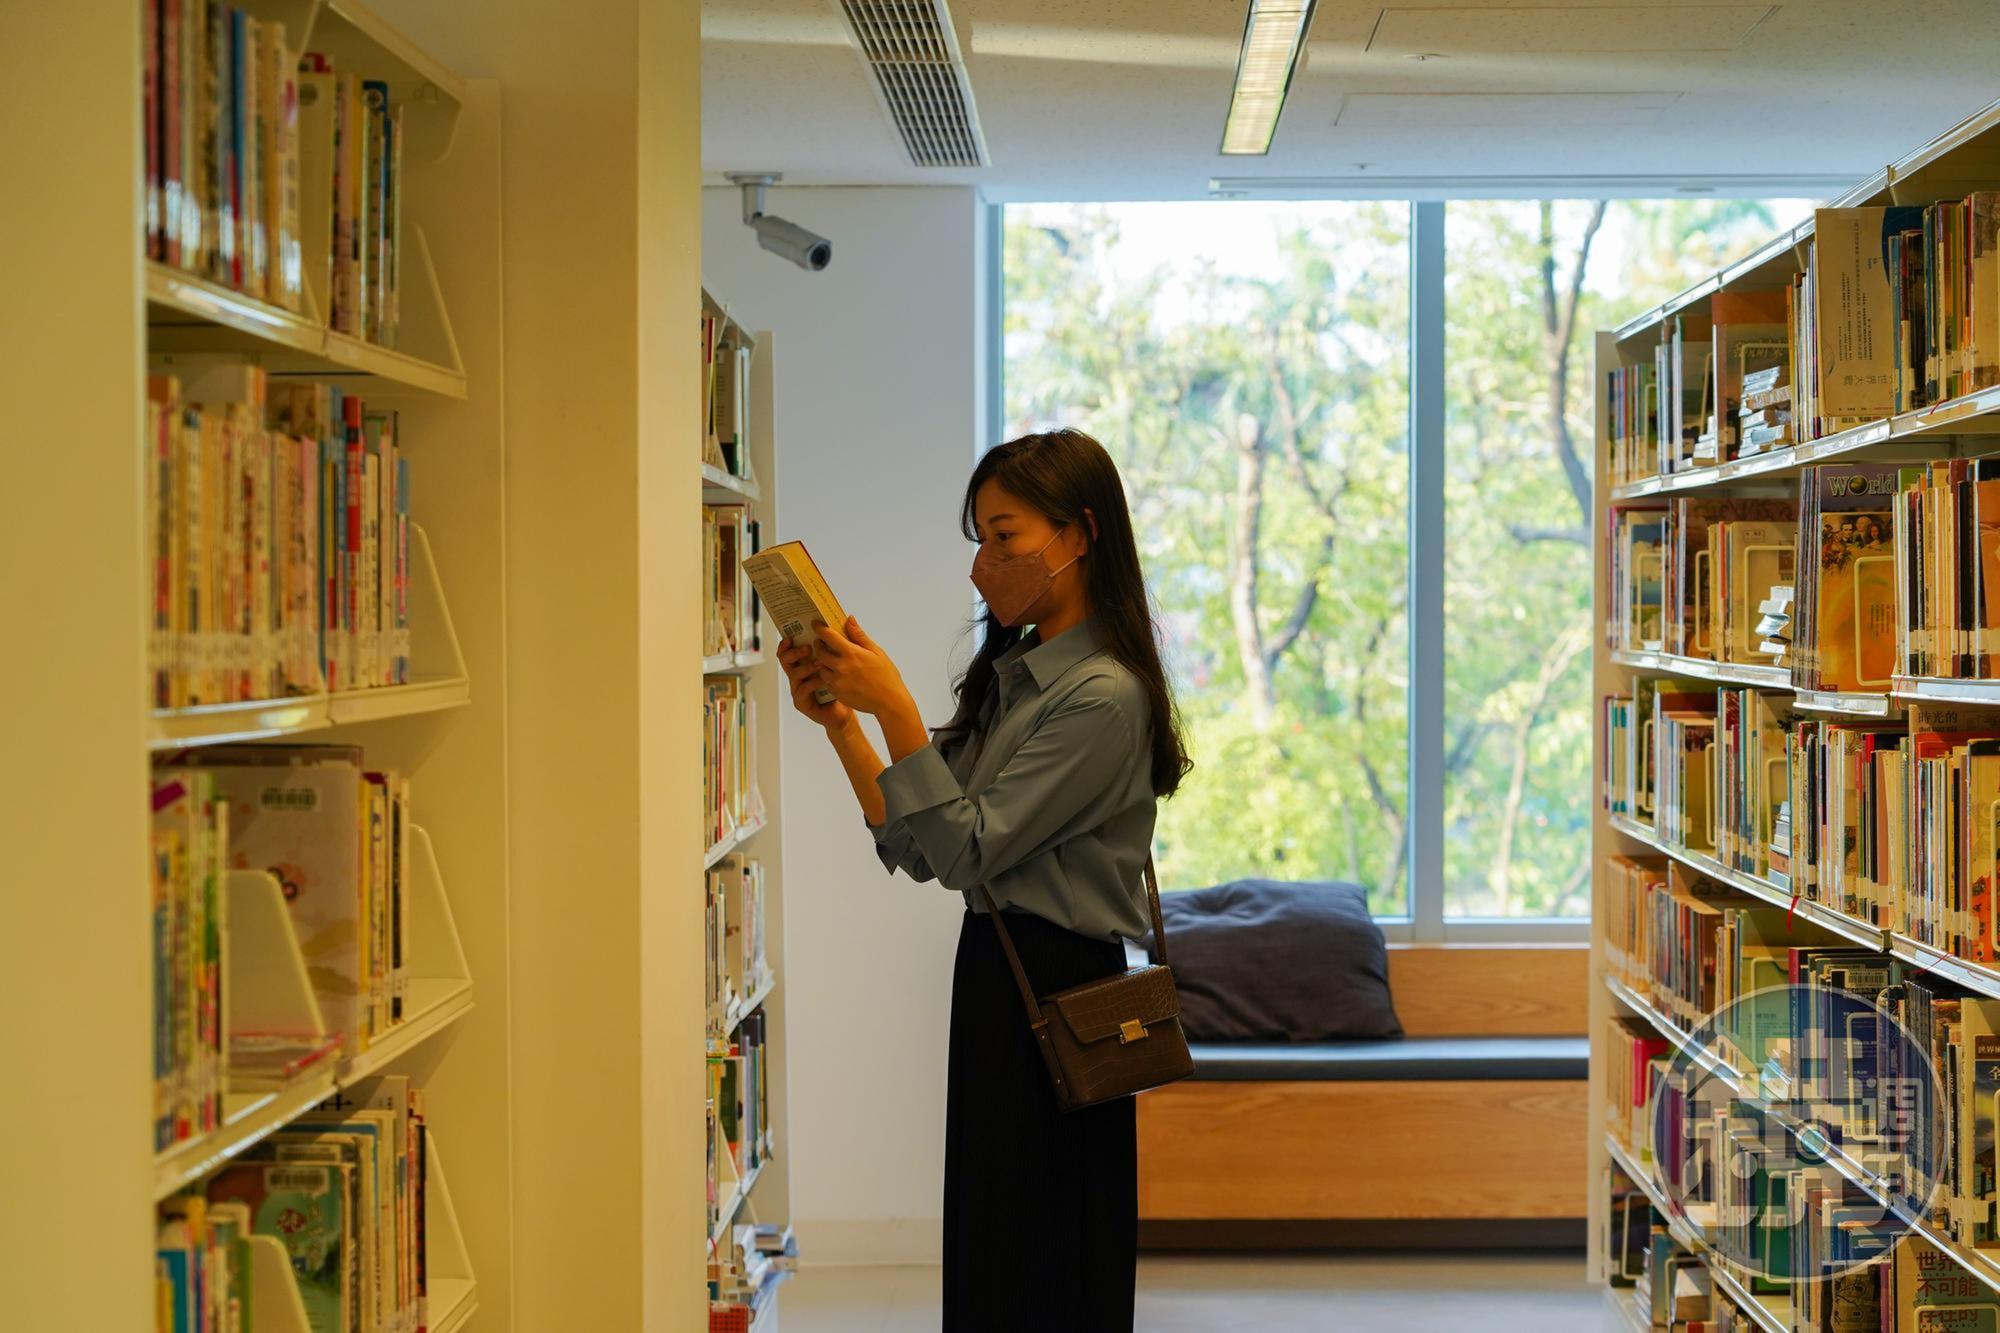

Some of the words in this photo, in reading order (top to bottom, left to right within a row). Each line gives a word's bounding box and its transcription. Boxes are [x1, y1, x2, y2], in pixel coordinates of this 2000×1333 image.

[1918, 710, 1958, 724] 時光的
[1916, 1251, 1966, 1271] 世界
[1917, 1276, 1979, 1297] 不可能
